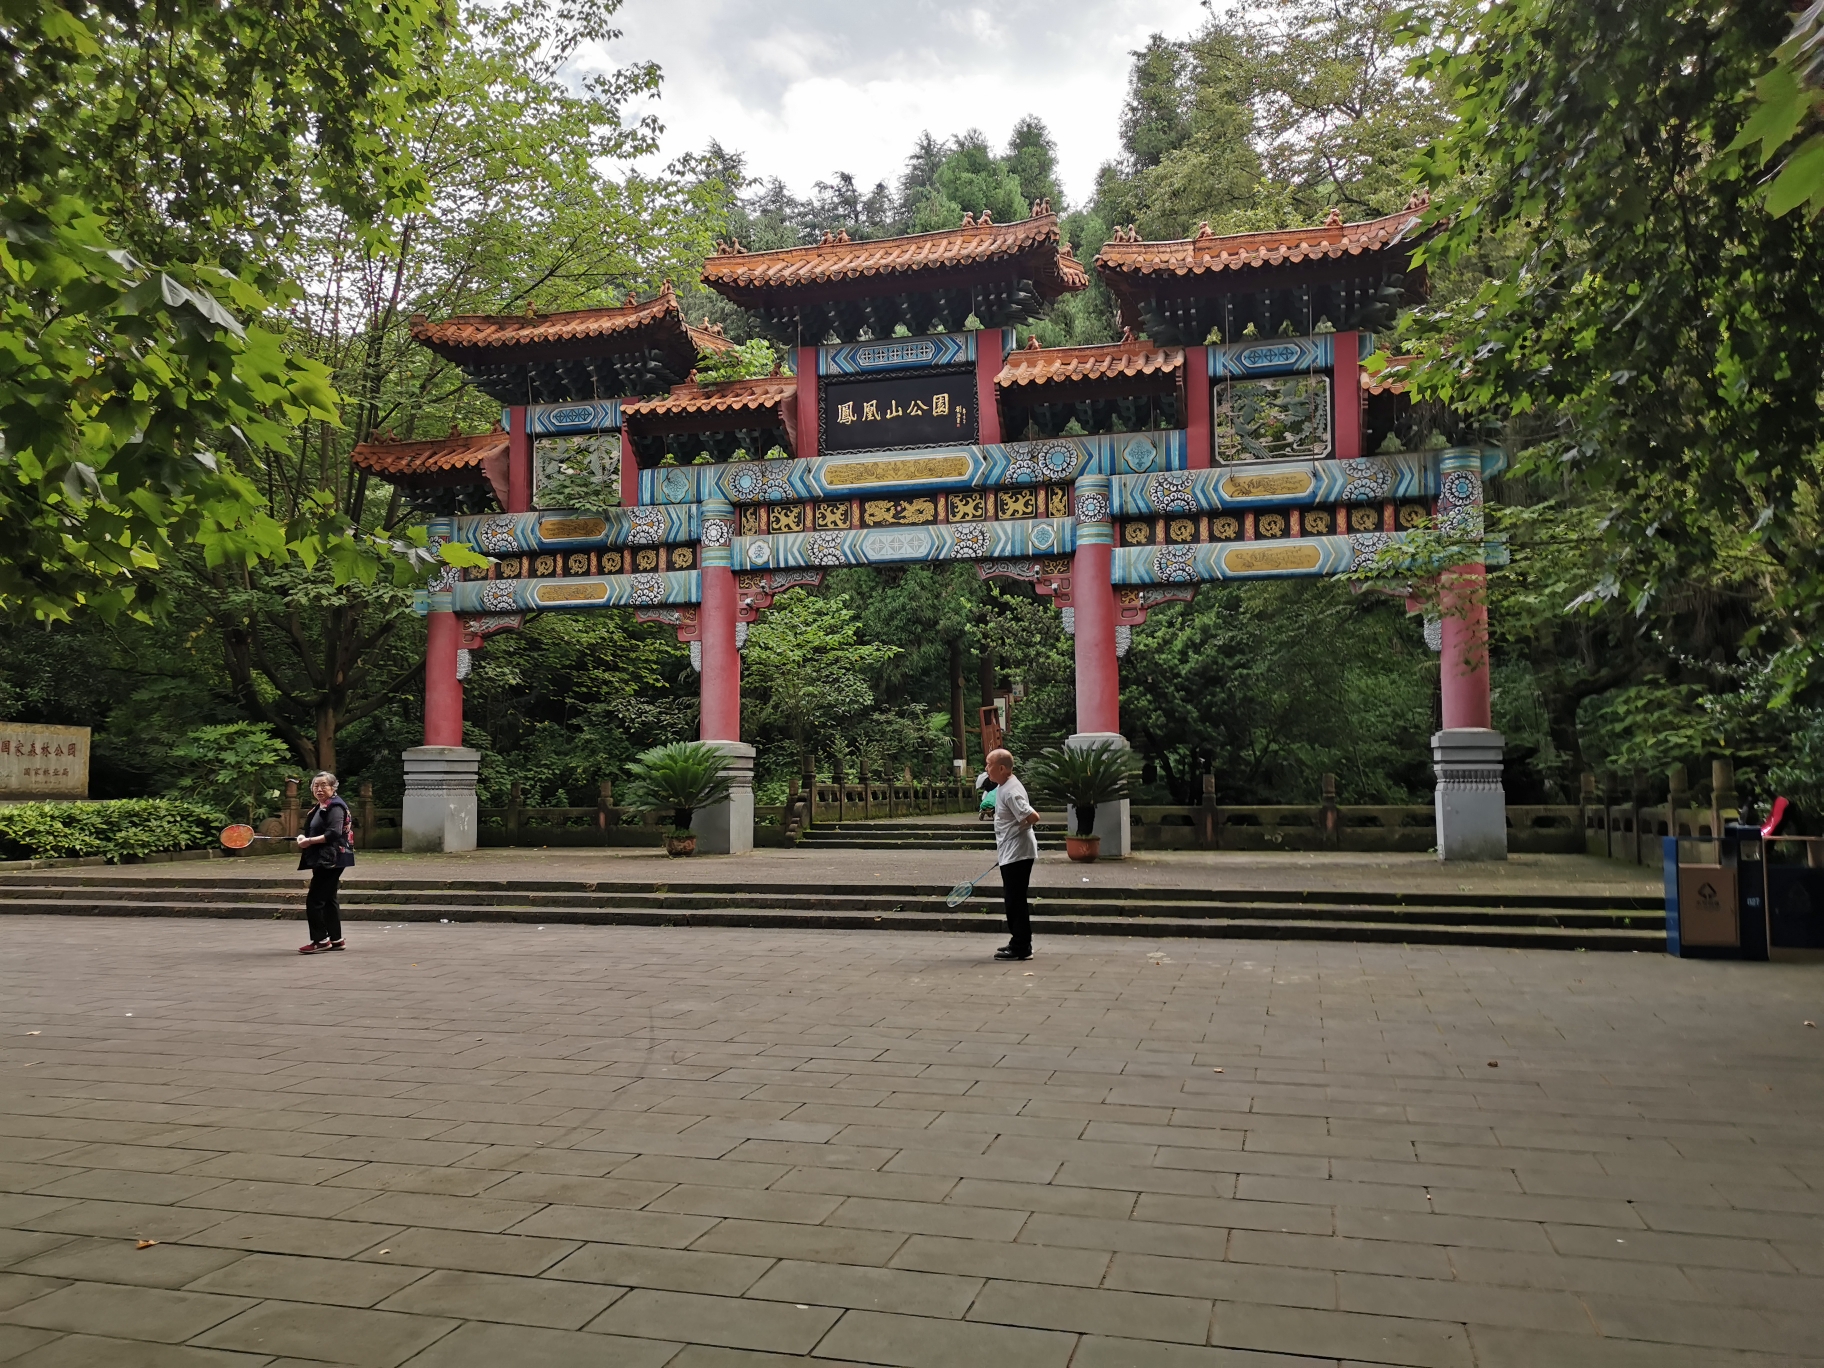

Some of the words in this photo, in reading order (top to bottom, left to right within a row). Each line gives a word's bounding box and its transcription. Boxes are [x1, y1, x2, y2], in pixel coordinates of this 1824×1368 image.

[837, 393, 949, 425] 鳳凰山公園
